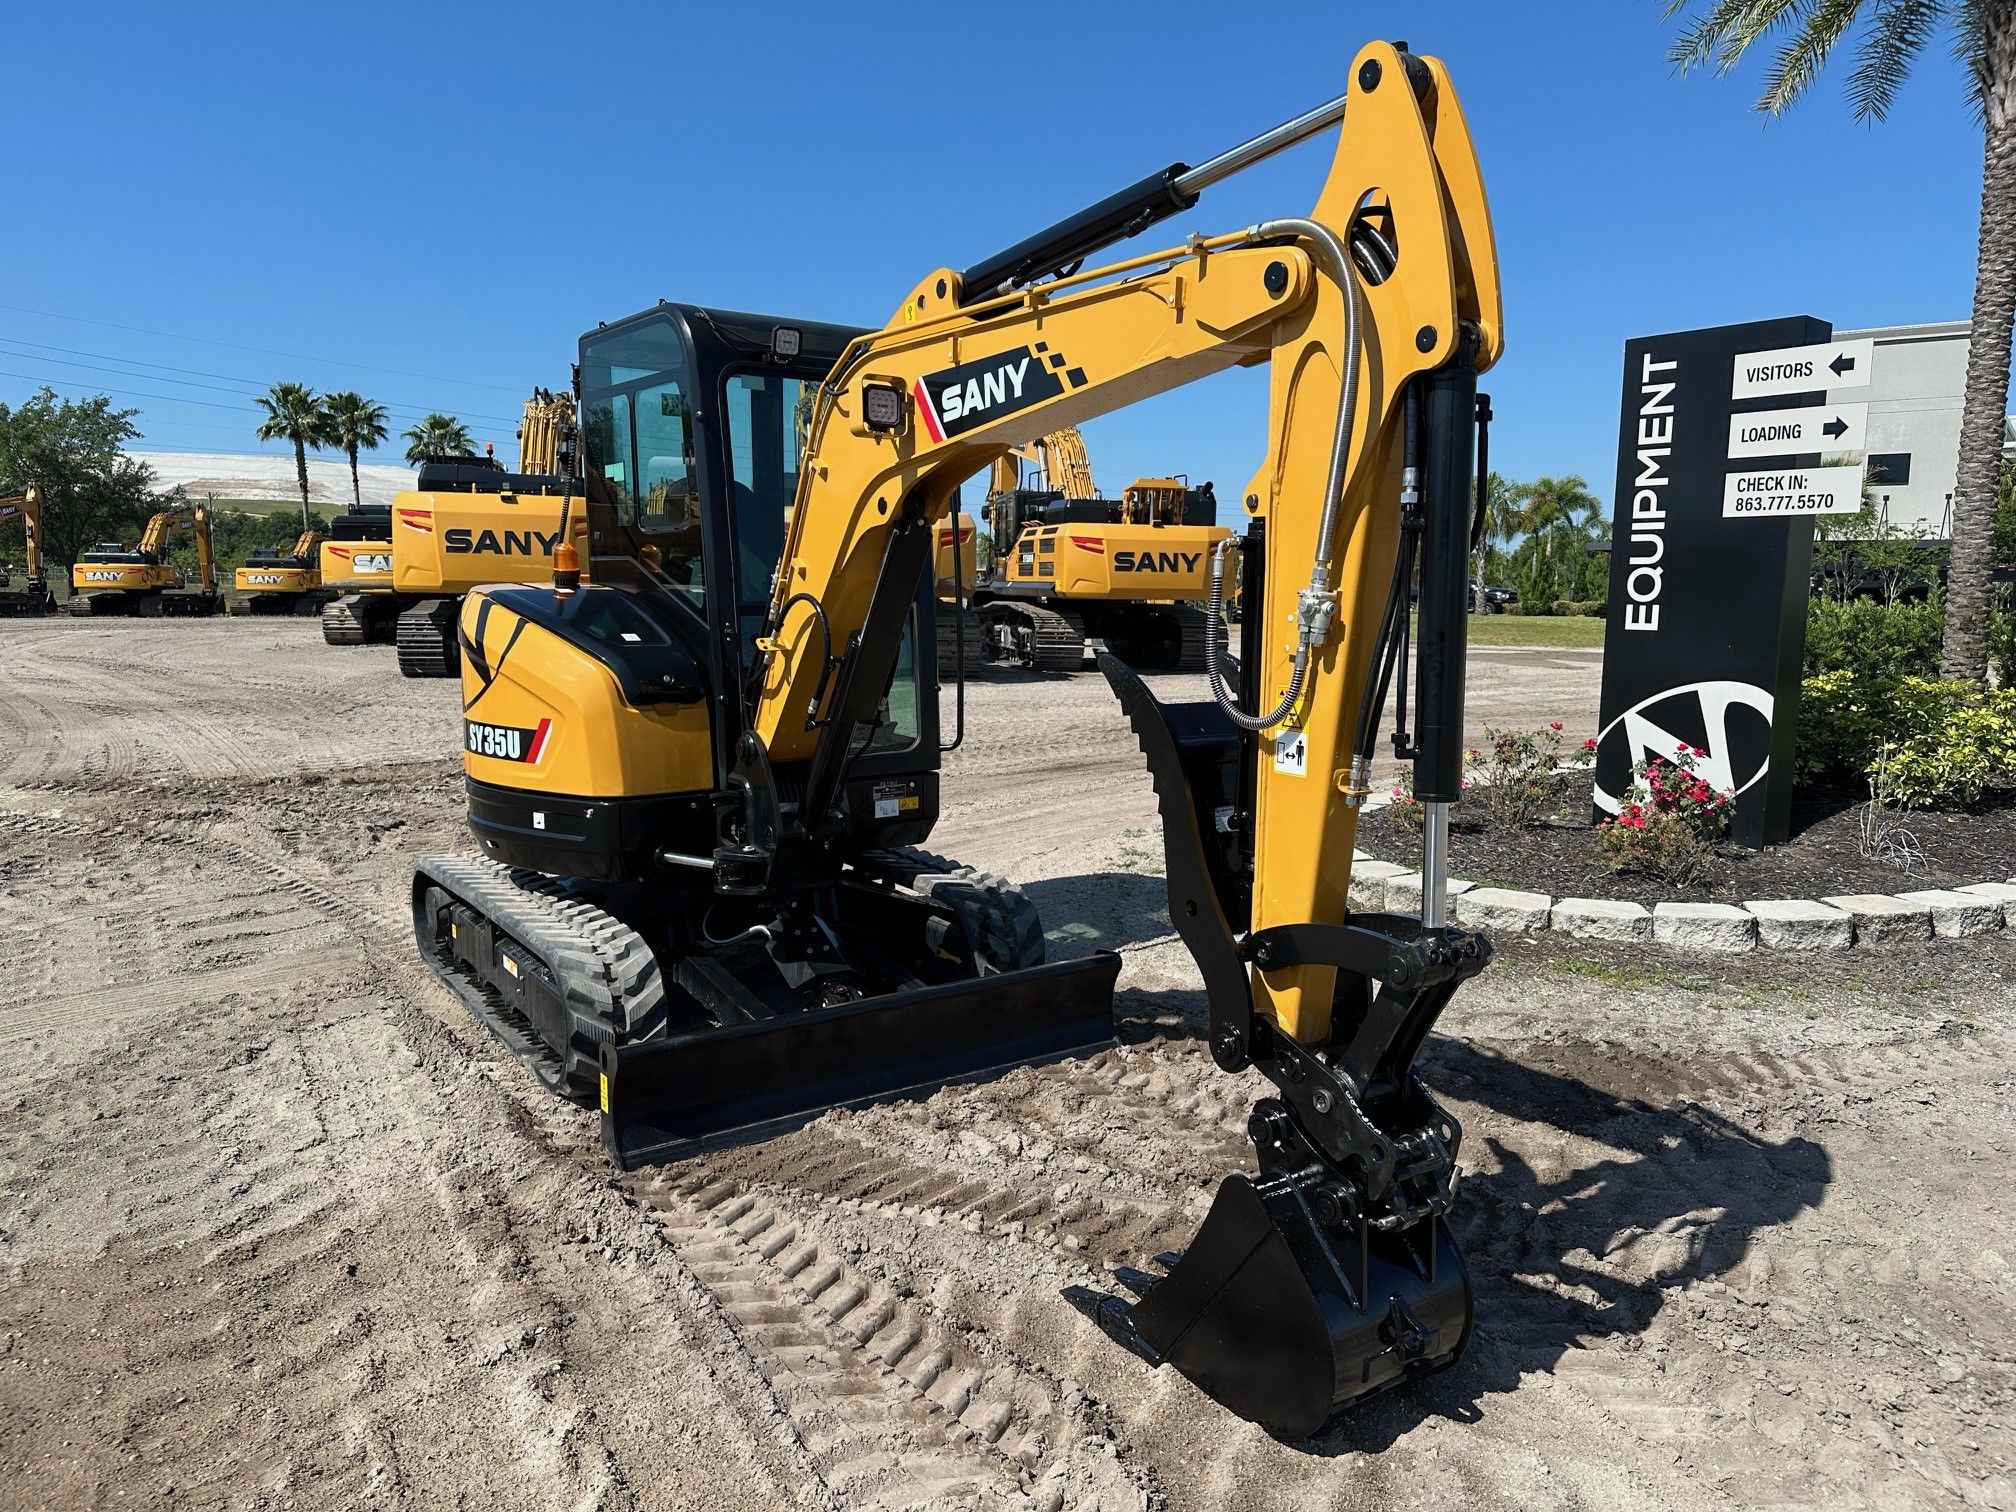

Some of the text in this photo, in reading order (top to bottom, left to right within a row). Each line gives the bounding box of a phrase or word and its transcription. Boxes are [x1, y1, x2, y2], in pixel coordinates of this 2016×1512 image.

[1746, 361, 1813, 383] VISITORS
[941, 356, 1030, 423] SANY
[1741, 424, 1802, 443] LOADING
[1624, 352, 1678, 632] EQUIPMENT
[1737, 474, 1808, 493] CHECK IN:
[1735, 493, 1834, 512] 863.777.5570
[444, 529, 560, 556] SANY
[353, 554, 393, 574] SA
[1114, 552, 1202, 573] SANY
[85, 571, 125, 582] SANY
[247, 575, 284, 585] SANY
[469, 723, 521, 759] SY35U
